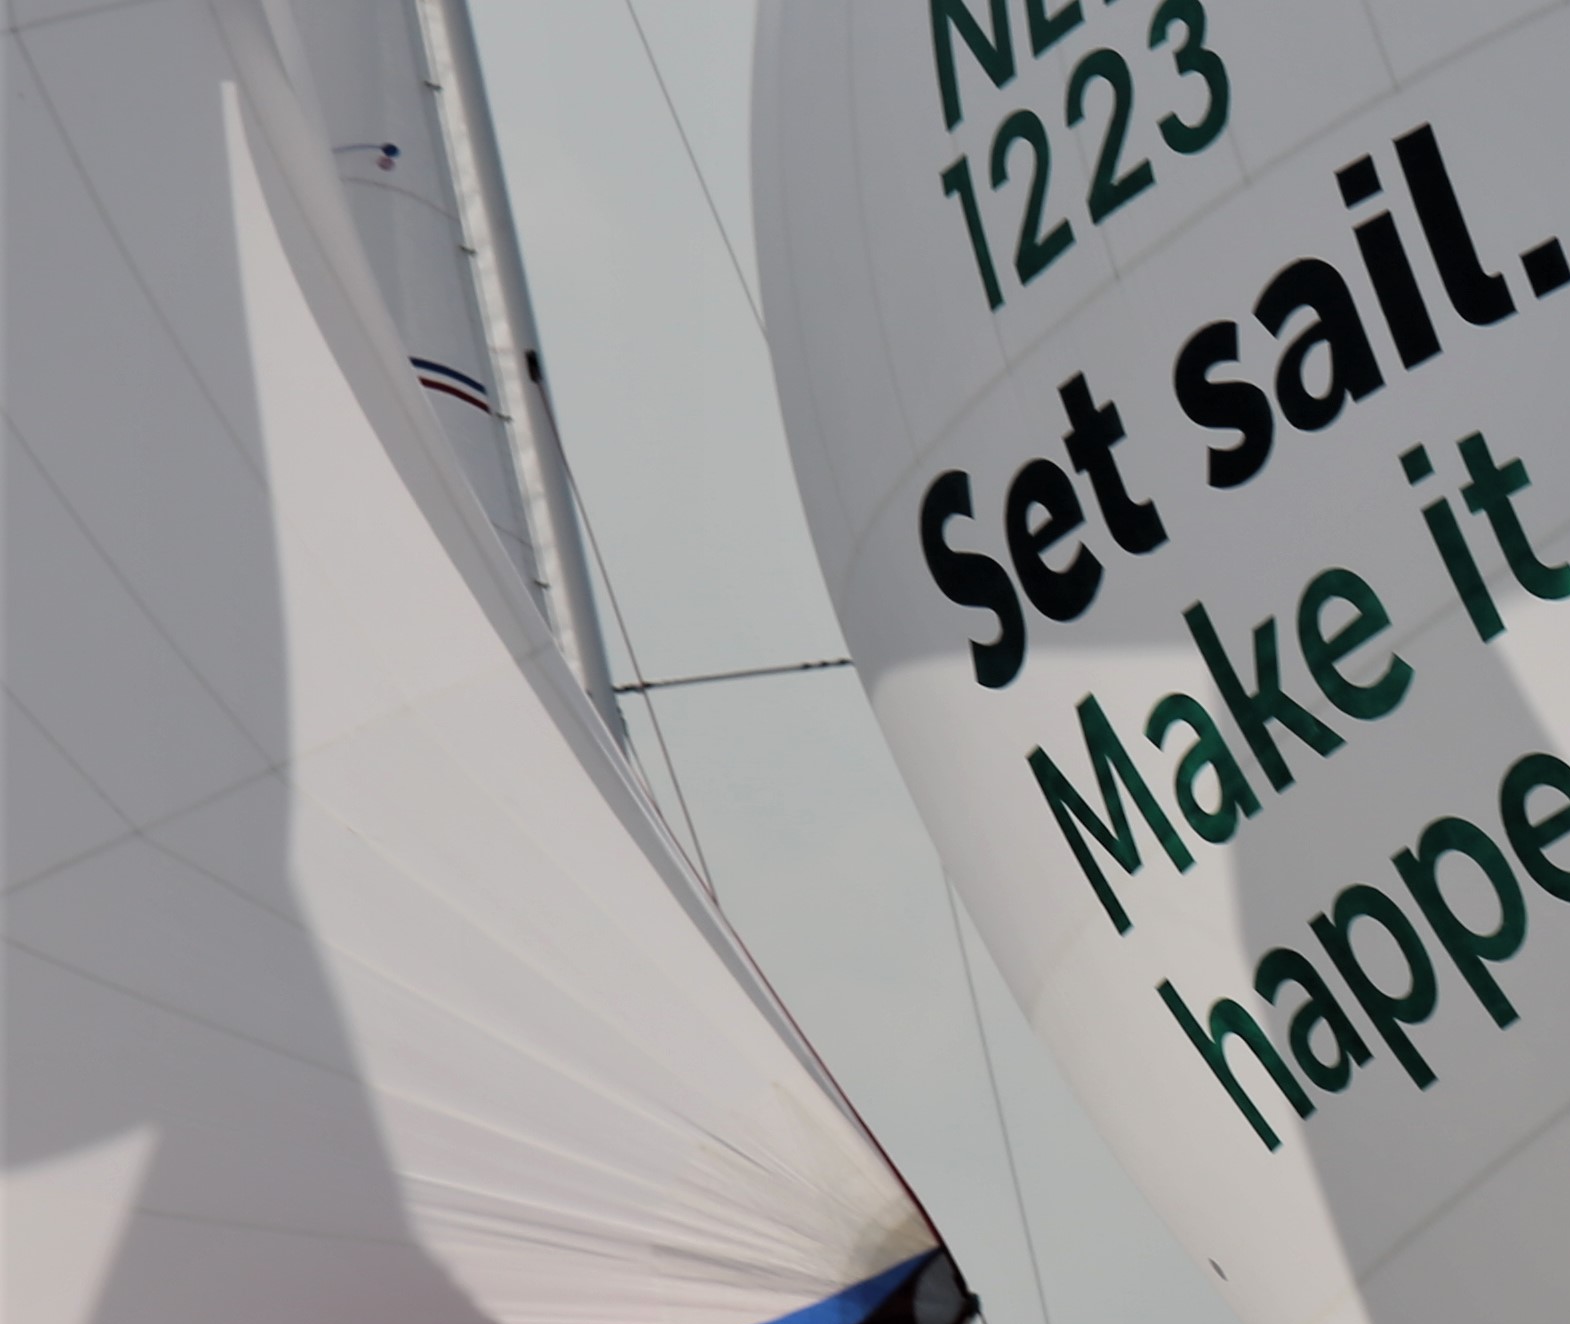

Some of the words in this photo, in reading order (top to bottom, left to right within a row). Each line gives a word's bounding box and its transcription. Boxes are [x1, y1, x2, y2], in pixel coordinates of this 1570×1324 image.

[940, 0, 1230, 312] 1223
[918, 371, 1169, 689] Set
[1026, 567, 1414, 936] Make
